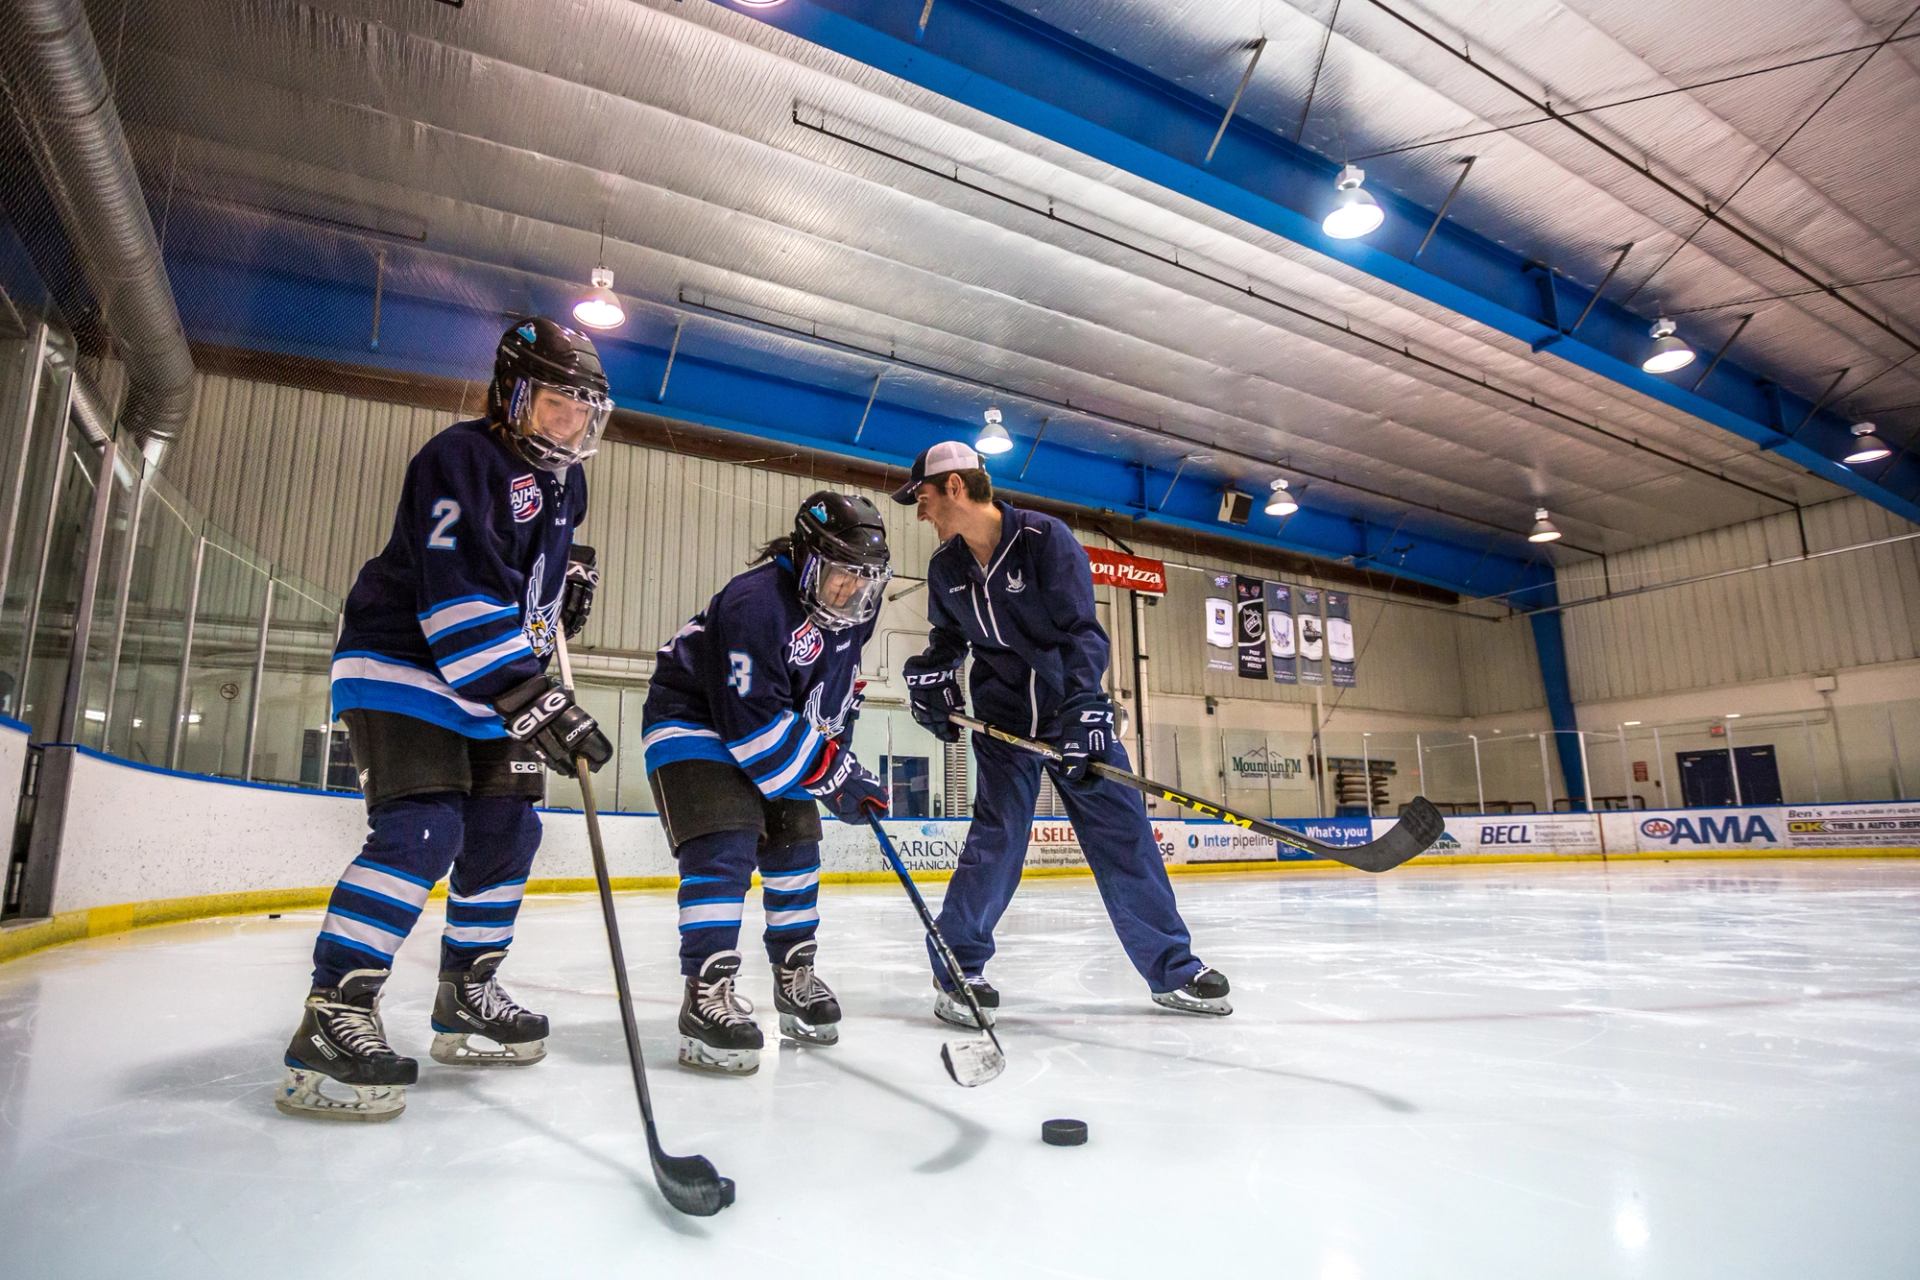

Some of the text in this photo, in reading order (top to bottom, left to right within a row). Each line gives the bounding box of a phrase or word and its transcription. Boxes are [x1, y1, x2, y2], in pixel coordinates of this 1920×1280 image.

[427, 497, 462, 551] 2
[1117, 563, 1161, 584] Pizza
[906, 670, 953, 686] CCM
[1162, 790, 1253, 830] CCM
[1788, 809, 1823, 818] Ben's
[1030, 827, 1076, 842] LSELE
[1305, 825, 1369, 841] What's your
[1670, 815, 1778, 845] AMA
[1790, 822, 1824, 832] OK
[1832, 822, 1855, 830] TIRE
[1868, 821, 1897, 829] AUTO
[1480, 825, 1532, 845] BECL
[882, 858, 958, 871] MCHANICAL
